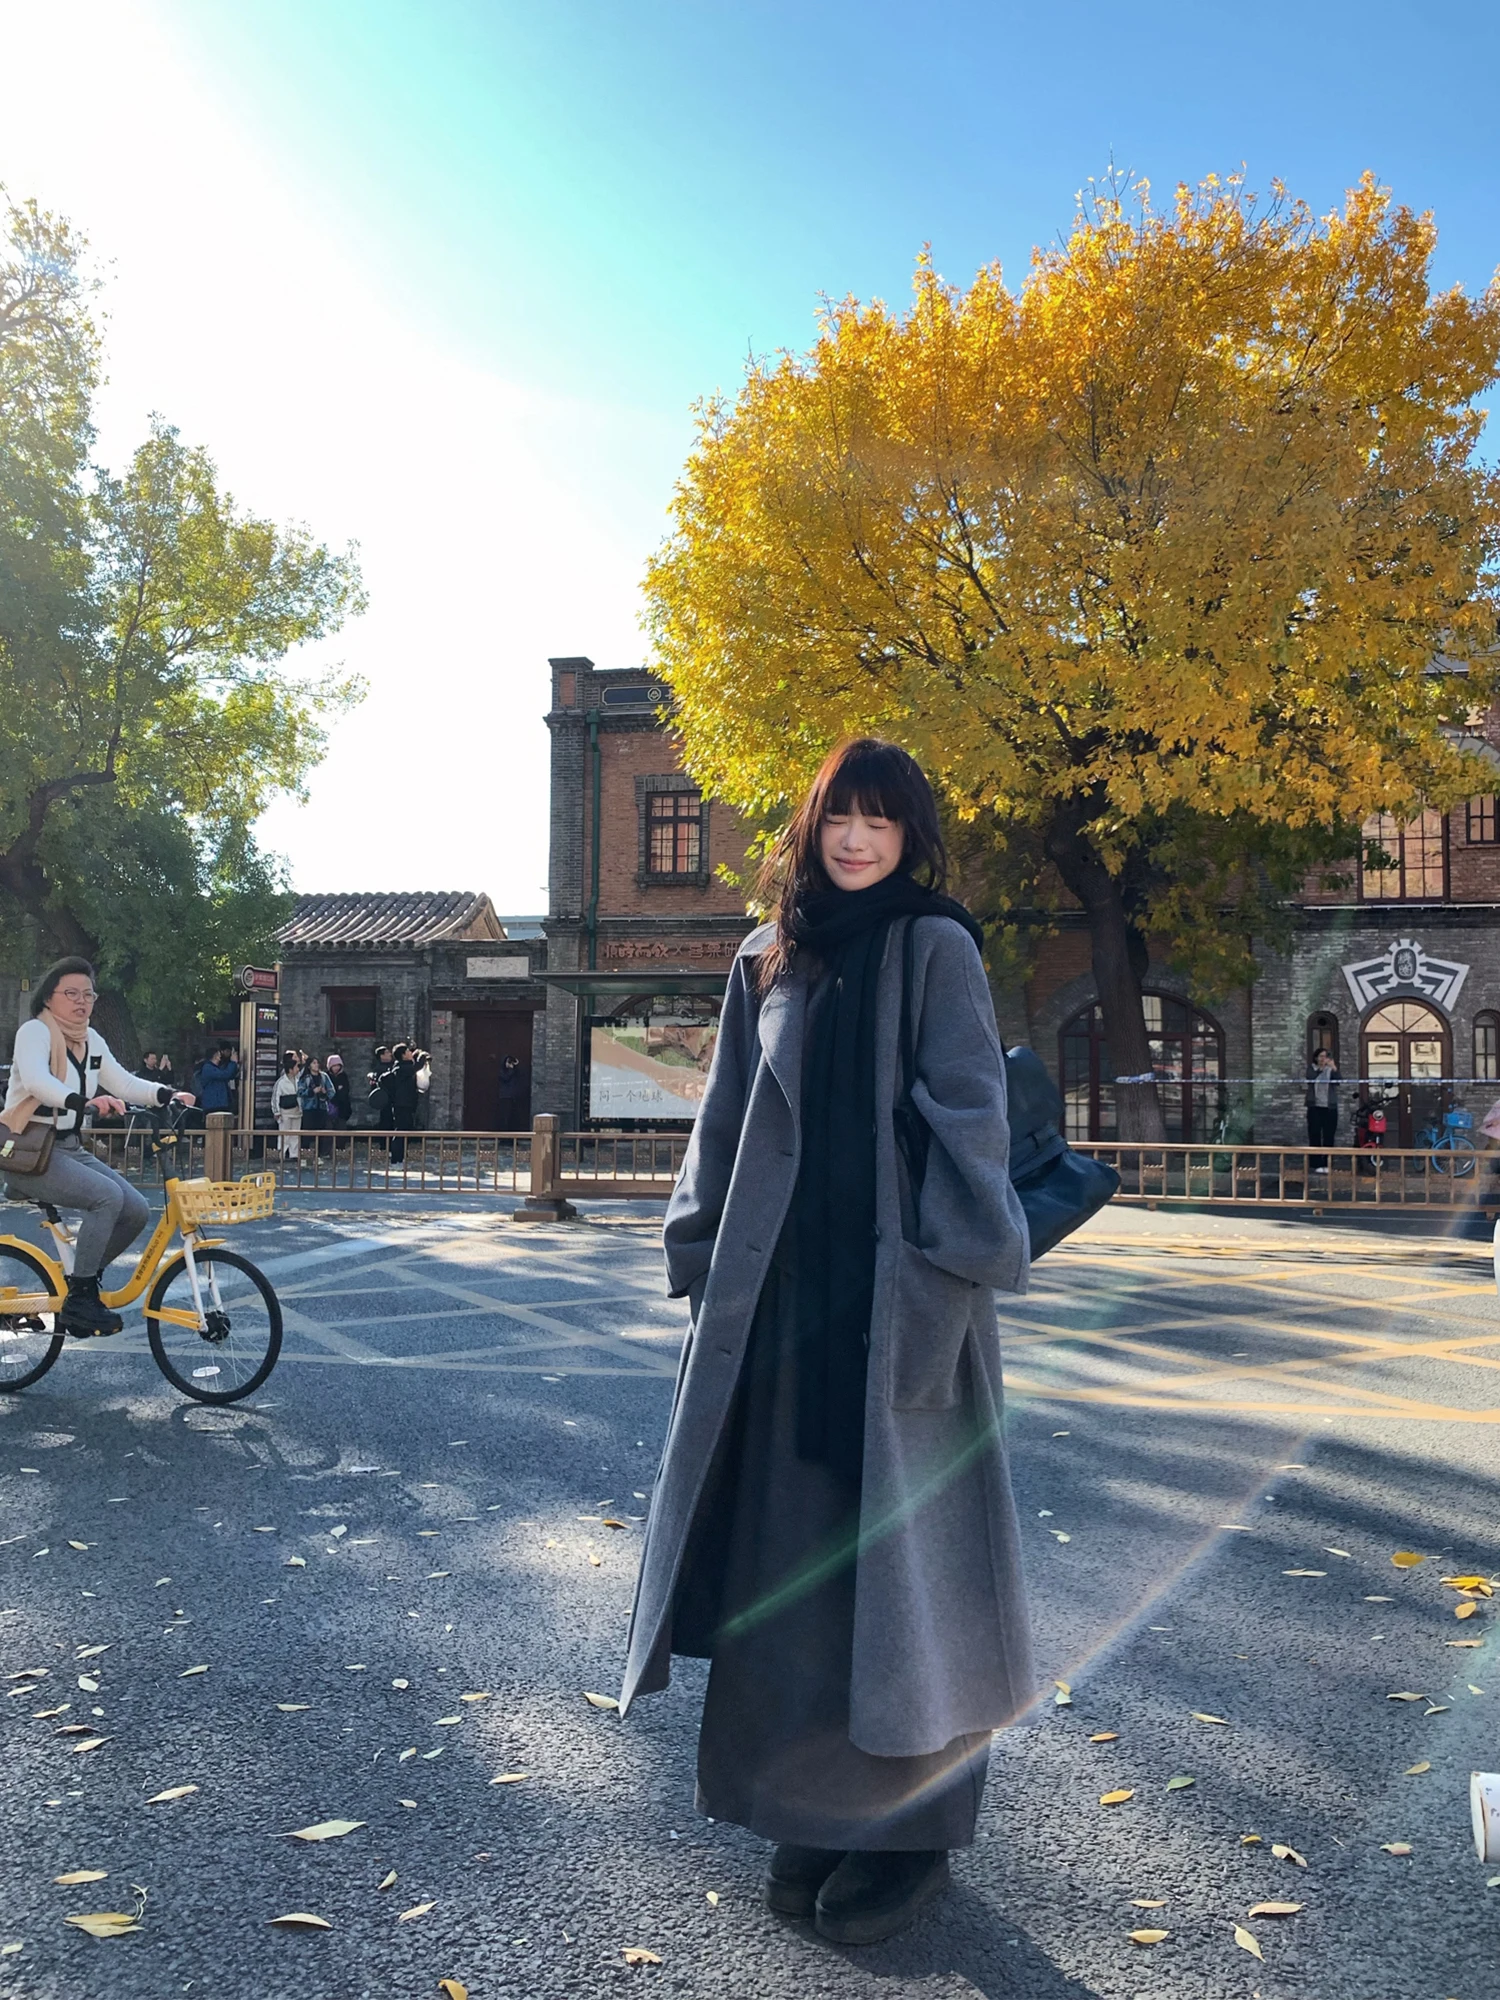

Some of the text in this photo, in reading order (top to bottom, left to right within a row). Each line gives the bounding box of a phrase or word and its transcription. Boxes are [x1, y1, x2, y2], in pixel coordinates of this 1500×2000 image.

[599, 1089, 664, 1103] 同一个地球
